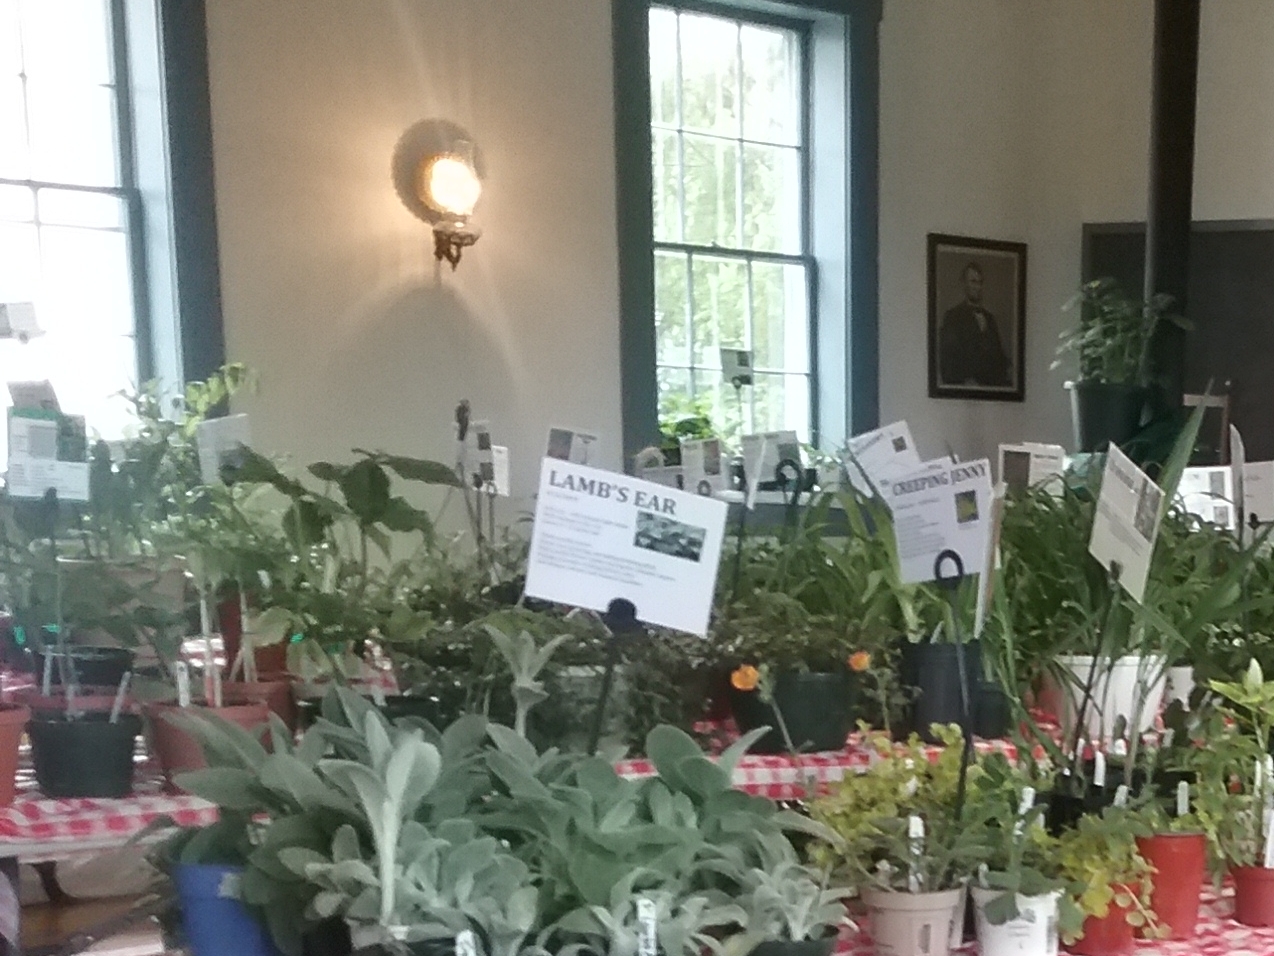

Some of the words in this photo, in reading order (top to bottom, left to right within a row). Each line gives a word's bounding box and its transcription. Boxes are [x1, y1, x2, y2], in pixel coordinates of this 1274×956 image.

[549, 470, 630, 503] LAMB'S
[633, 490, 678, 515] EAR
[893, 472, 948, 496] CREEPING
[951, 464, 986, 486] JENNY
